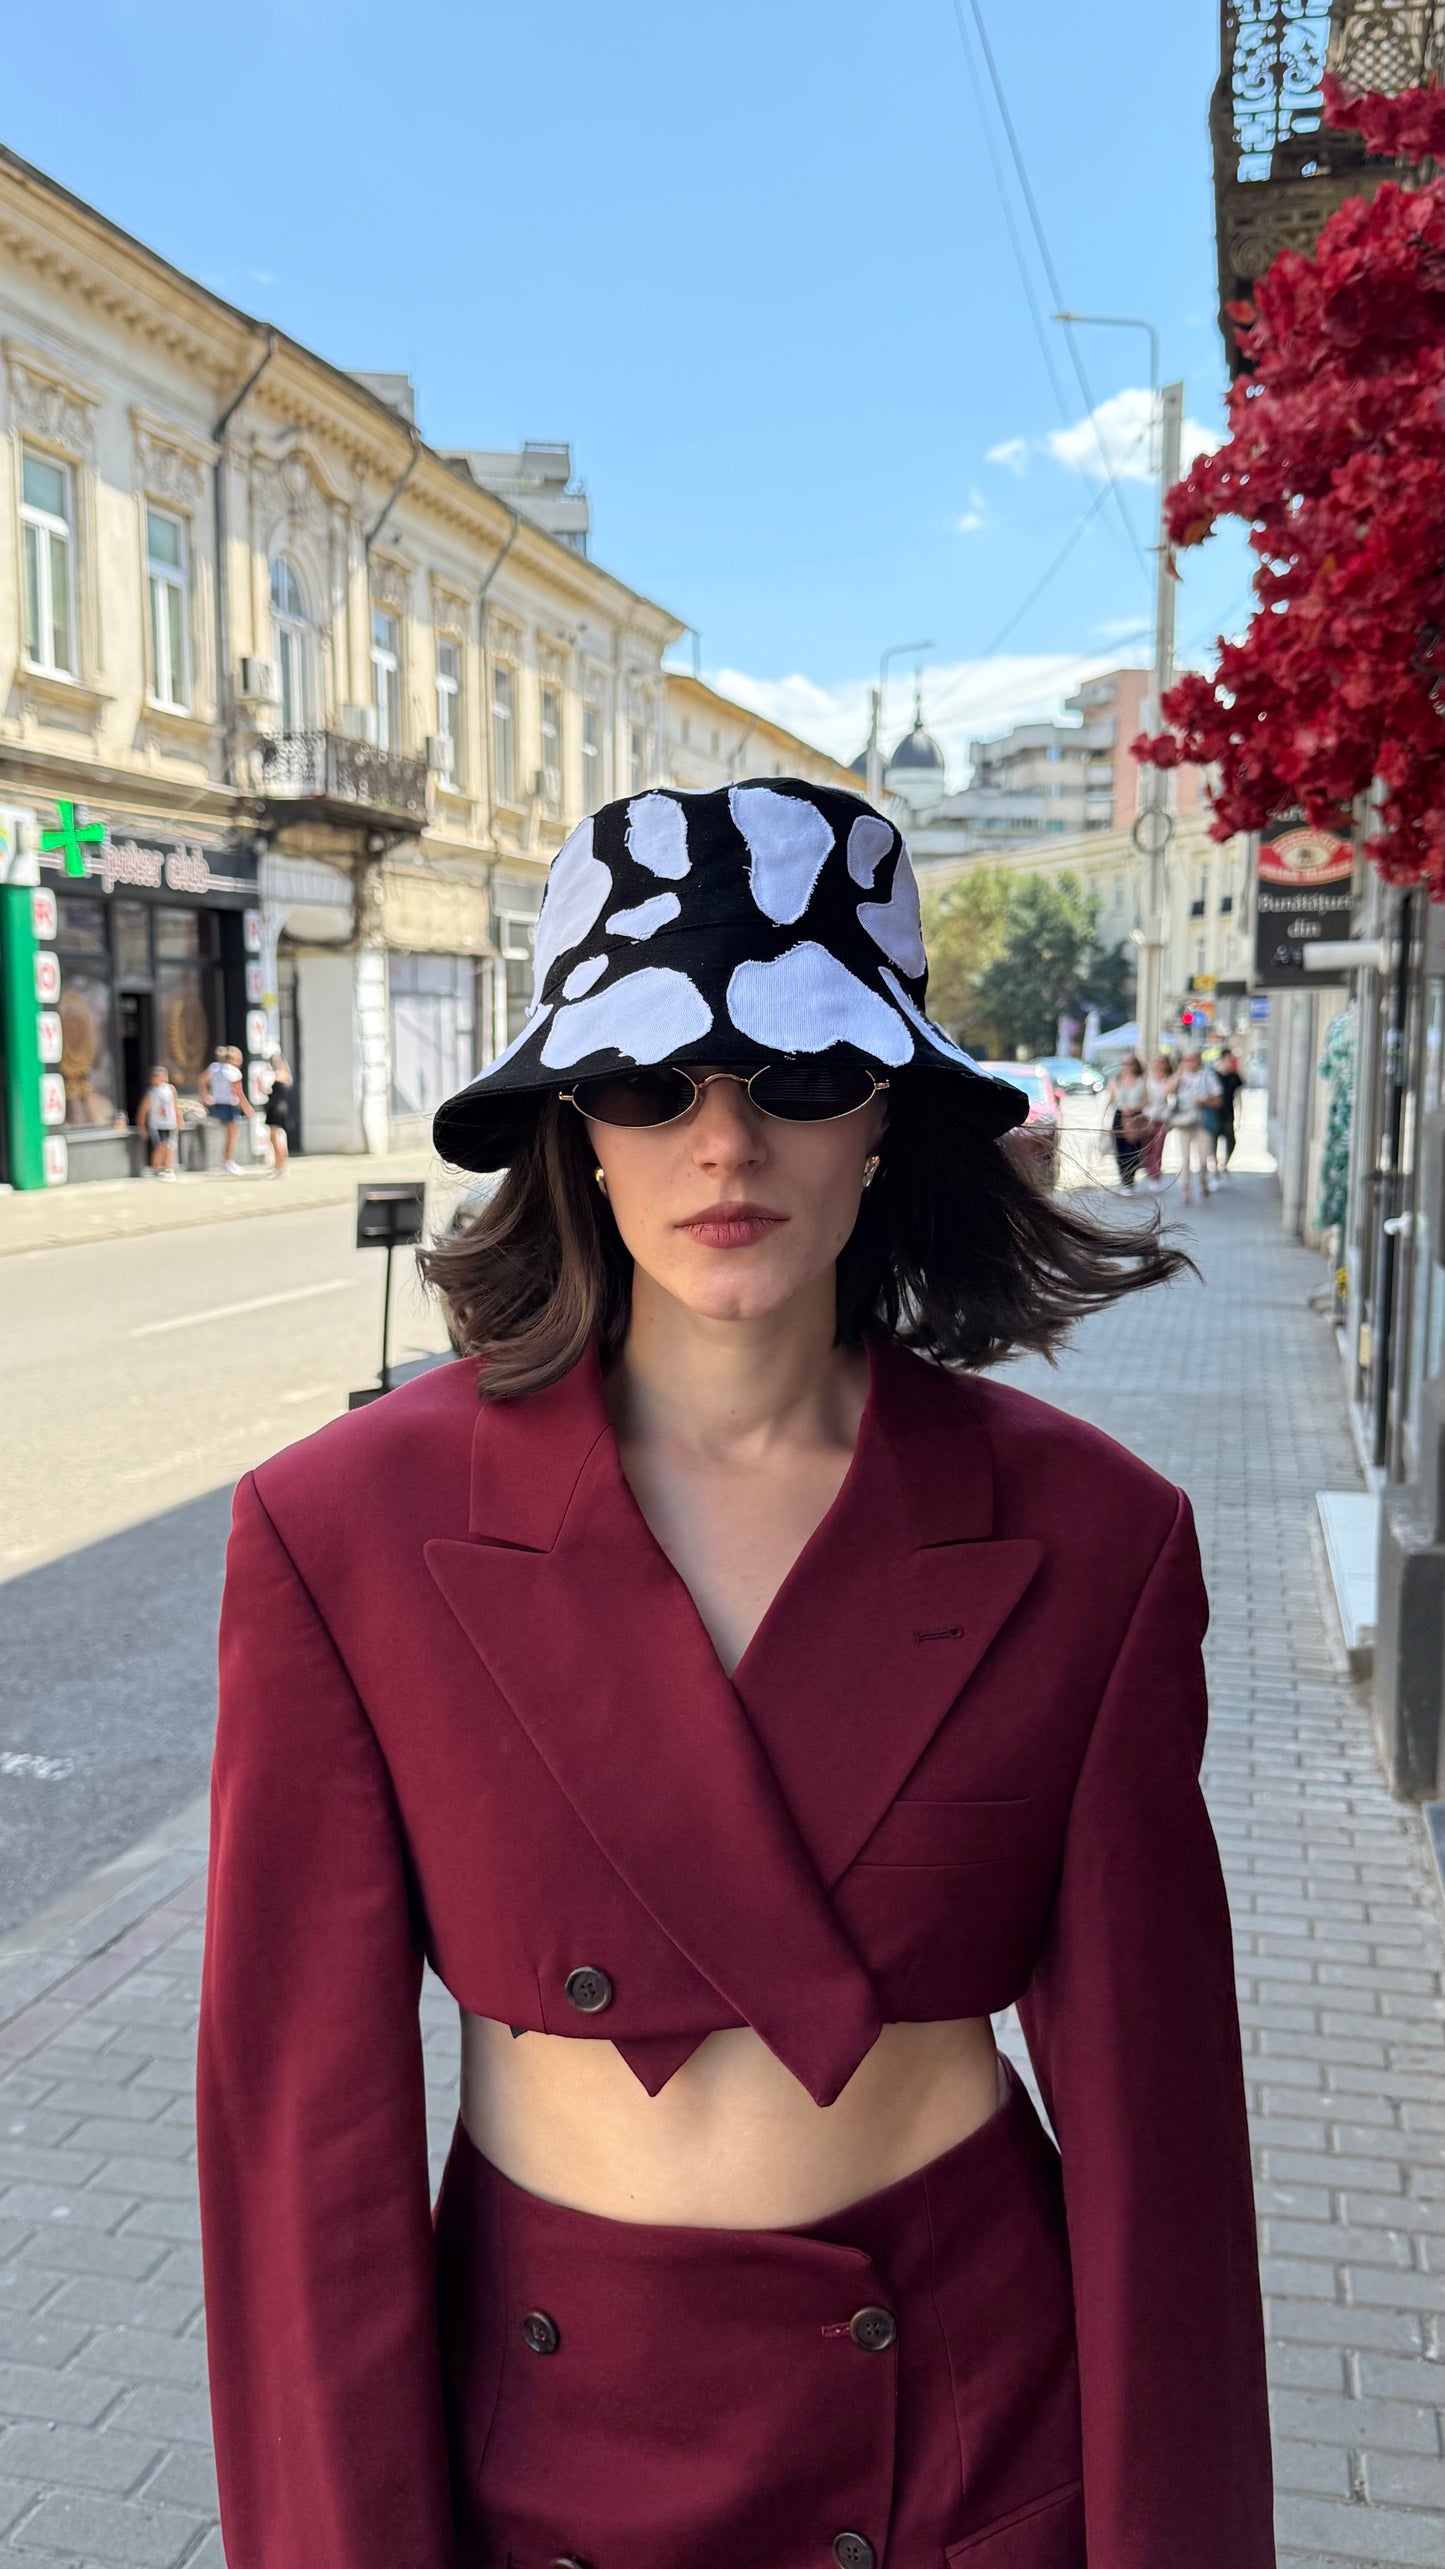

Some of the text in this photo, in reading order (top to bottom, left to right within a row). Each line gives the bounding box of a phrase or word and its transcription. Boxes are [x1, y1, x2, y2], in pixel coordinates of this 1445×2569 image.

[102, 840, 210, 894] poker club
[33, 899, 67, 1176] ROYAL
